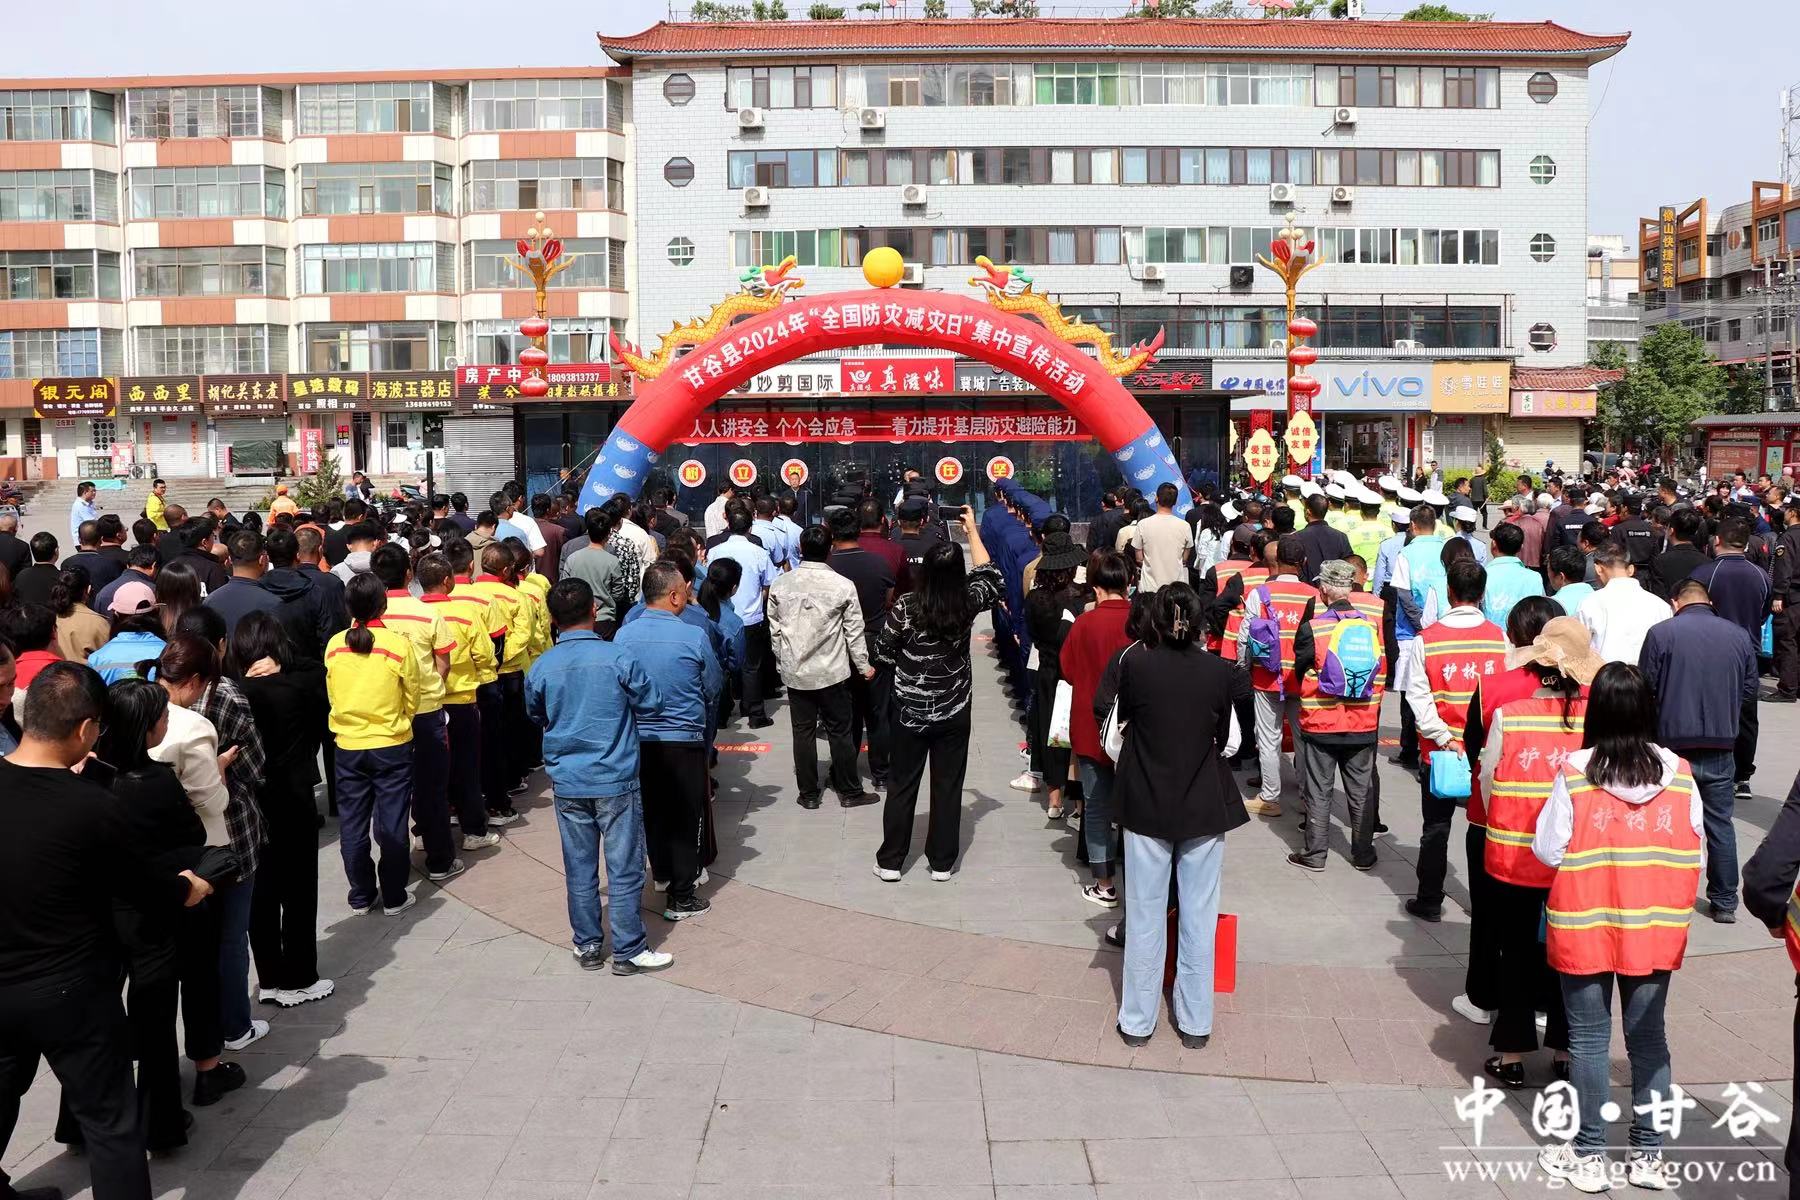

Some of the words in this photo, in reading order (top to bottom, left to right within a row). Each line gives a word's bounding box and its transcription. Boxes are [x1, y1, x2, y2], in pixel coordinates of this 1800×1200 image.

[682, 303, 1087, 395] 甘谷县2024年“全国防灾减灾日”集中宣传活动
[547, 372, 600, 383] 18093813737
[757, 374, 834, 393] 妙剪国际
[880, 364, 944, 392] 真滋味
[1242, 377, 1286, 390] 中国电信
[1333, 369, 1424, 397] vivo
[40, 385, 108, 401] 银元阁
[129, 383, 192, 402] 西西里
[207, 381, 279, 402] 胡记关东煮
[372, 379, 452, 399] 海波玉器店
[316, 398, 338, 409] 照相
[690, 417, 770, 438] 人人讲安全
[776, 415, 1078, 438] 个个会应急——着力提升基层防灾避险能力
[1290, 426, 1311, 437] 诚信
[1251, 445, 1271, 455] 爱国
[1290, 439, 1311, 449] 友善
[736, 467, 750, 480] 立
[942, 464, 956, 478] 在
[1251, 458, 1271, 468] 敬业
[1441, 661, 1495, 682] 护林员
[1592, 804, 1674, 833] 护林员
